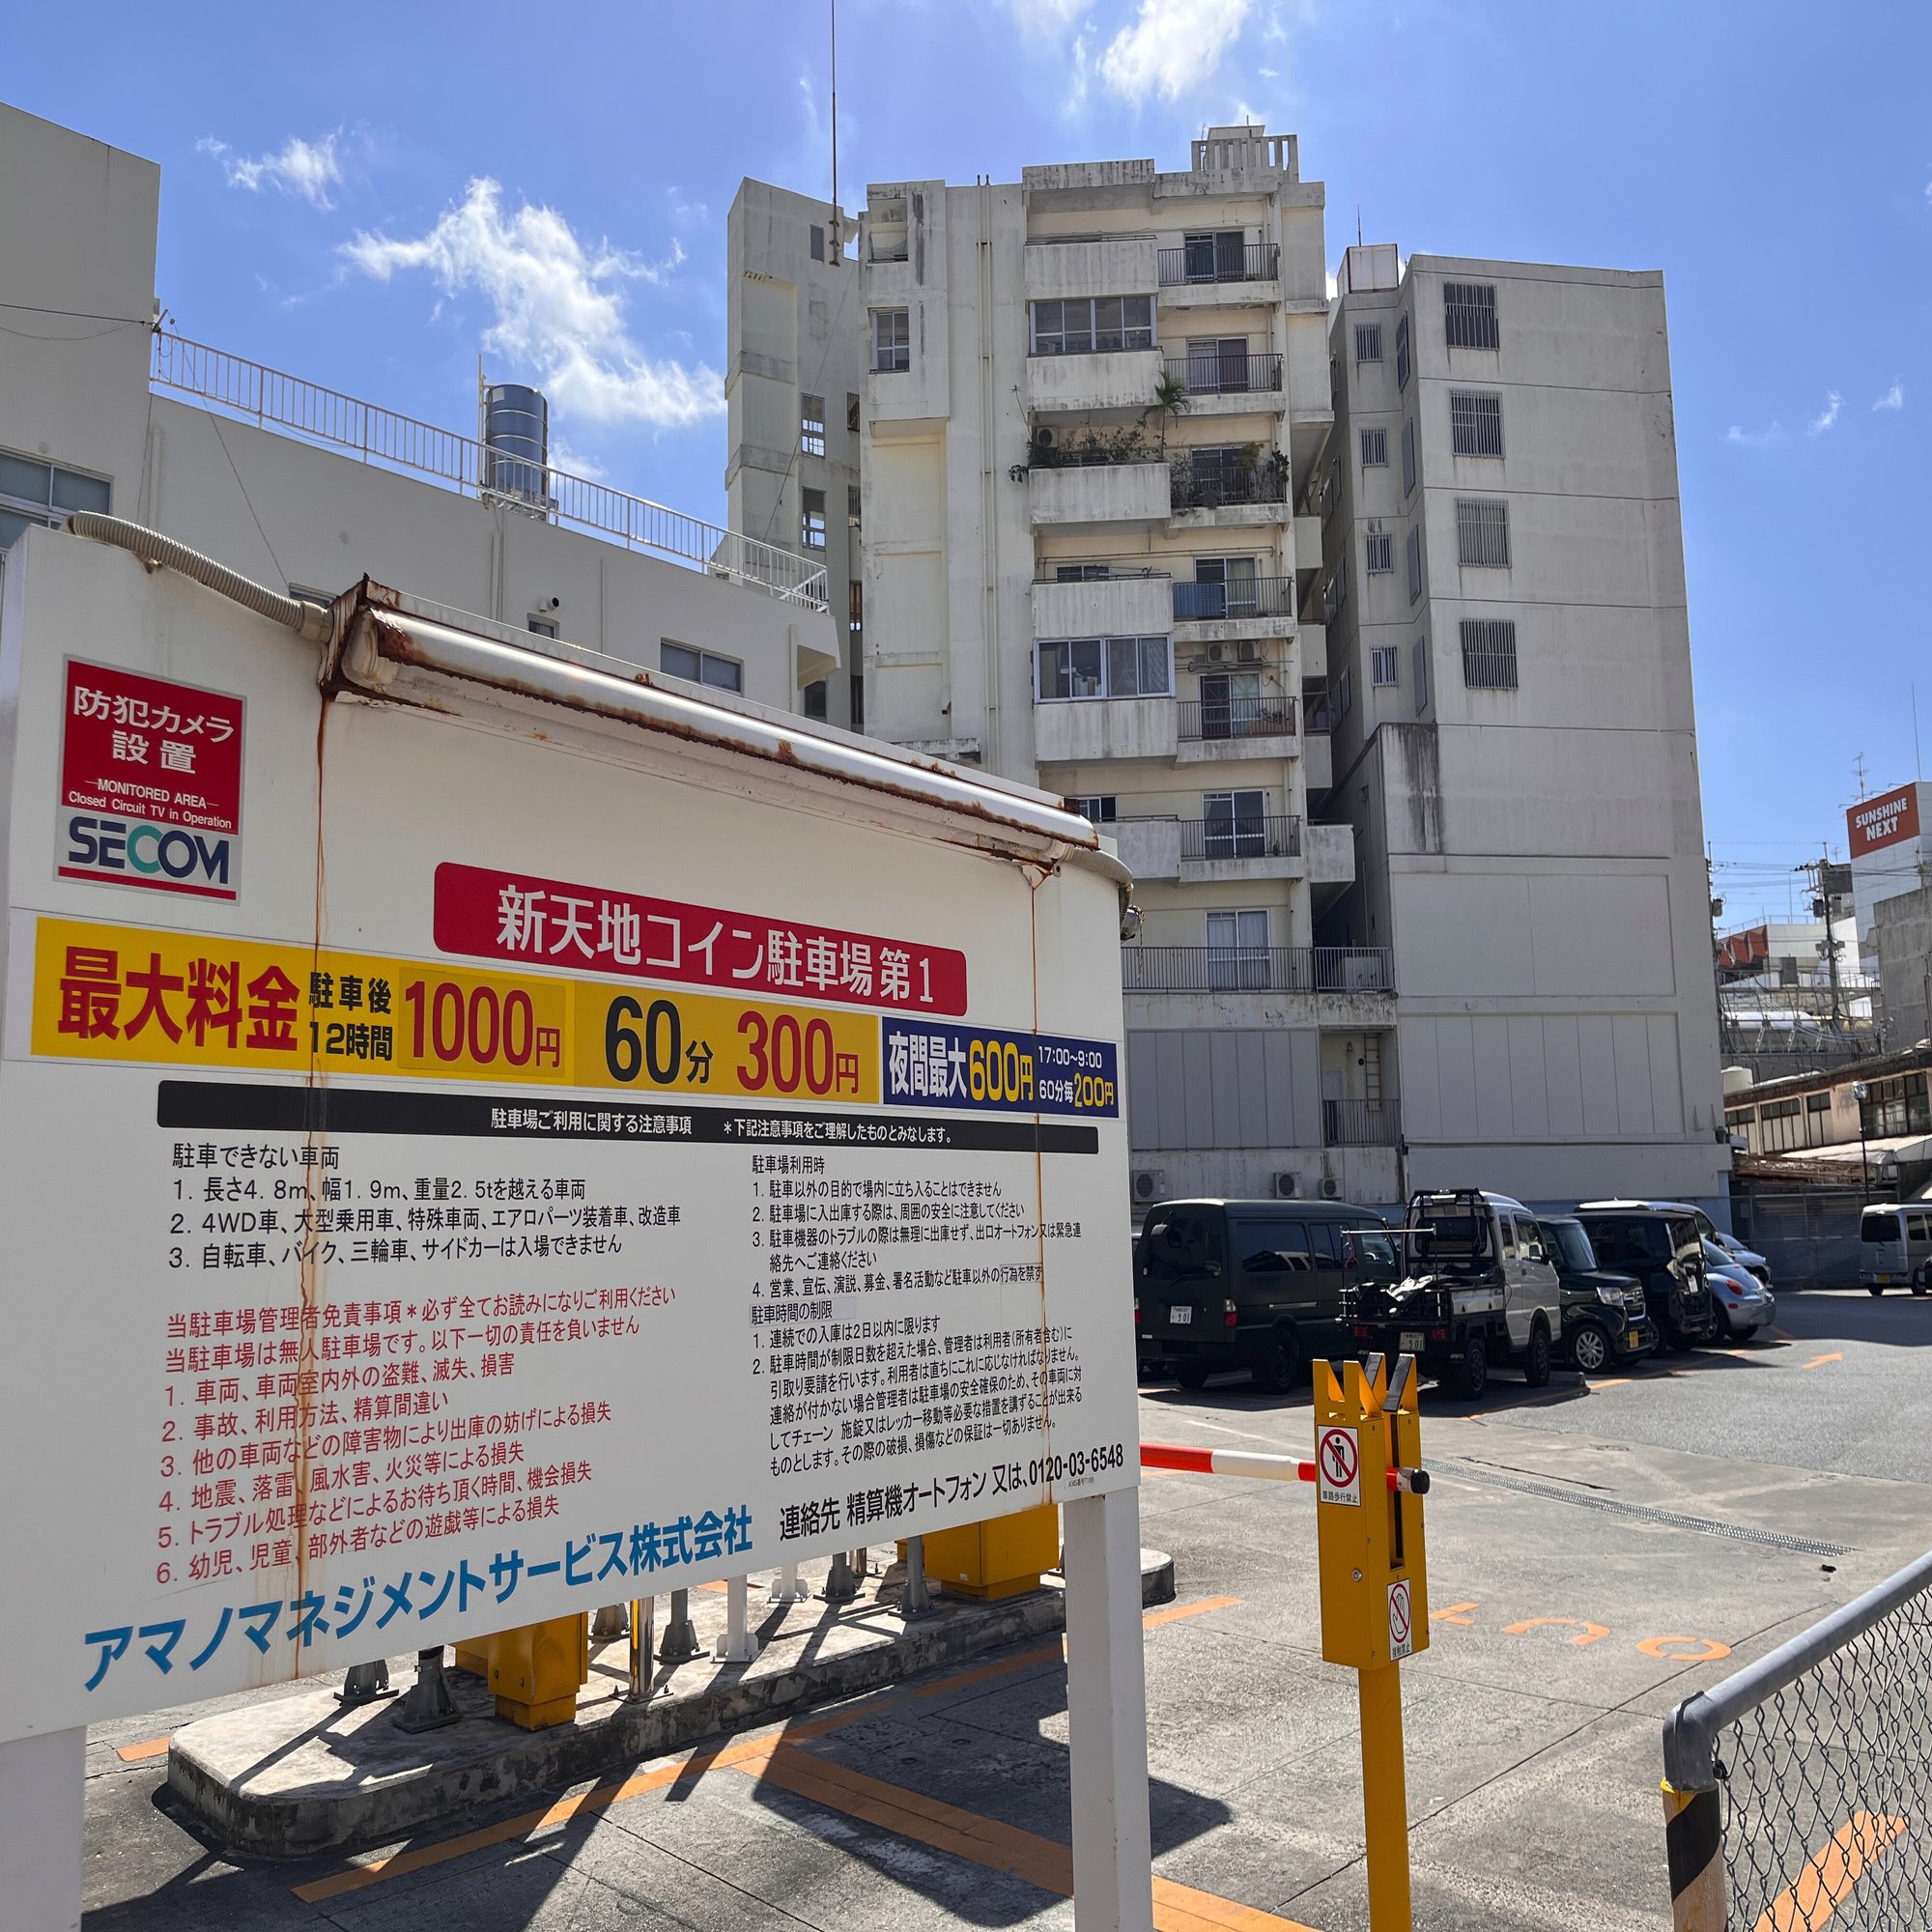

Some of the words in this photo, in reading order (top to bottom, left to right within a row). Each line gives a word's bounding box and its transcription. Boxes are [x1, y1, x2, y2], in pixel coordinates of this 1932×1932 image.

[73, 685, 235, 743] 防犯カメラ
[112, 729, 196, 775] 設置
[68, 790, 106, 809] Closed
[112, 798, 146, 815] Circuit
[150, 805, 165, 818] TV
[169, 808, 179, 820] in
[183, 810, 233, 830] Operation
[97, 778, 170, 803] MONITORED
[174, 793, 207, 810] AREA
[1855, 797, 1908, 829] SUNSHINE
[1865, 816, 1898, 841] NEXT
[68, 815, 230, 885] SECOM
[497, 884, 934, 1004] 新天地コイン駐車場第1
[58, 945, 300, 1052] 最大料金
[308, 971, 392, 1015] 駐車後
[309, 1021, 393, 1062] 12時間
[404, 980, 561, 1069] 1000円
[604, 994, 713, 1085] 60分
[736, 1009, 860, 1095] 300円
[491, 1107, 693, 1135] 駐車場ご利用に関する注意事項
[172, 1142, 340, 1170] 駐車できない車両
[752, 1154, 825, 1175] 駐車場利用時
[769, 1250, 877, 1273] 絡先へご連絡ください
[752, 1300, 833, 1325] 駐車時間の制限
[780, 1496, 840, 1542] 連絡先
[84, 1504, 753, 1692] アマノマネジメントサービス株式会社
